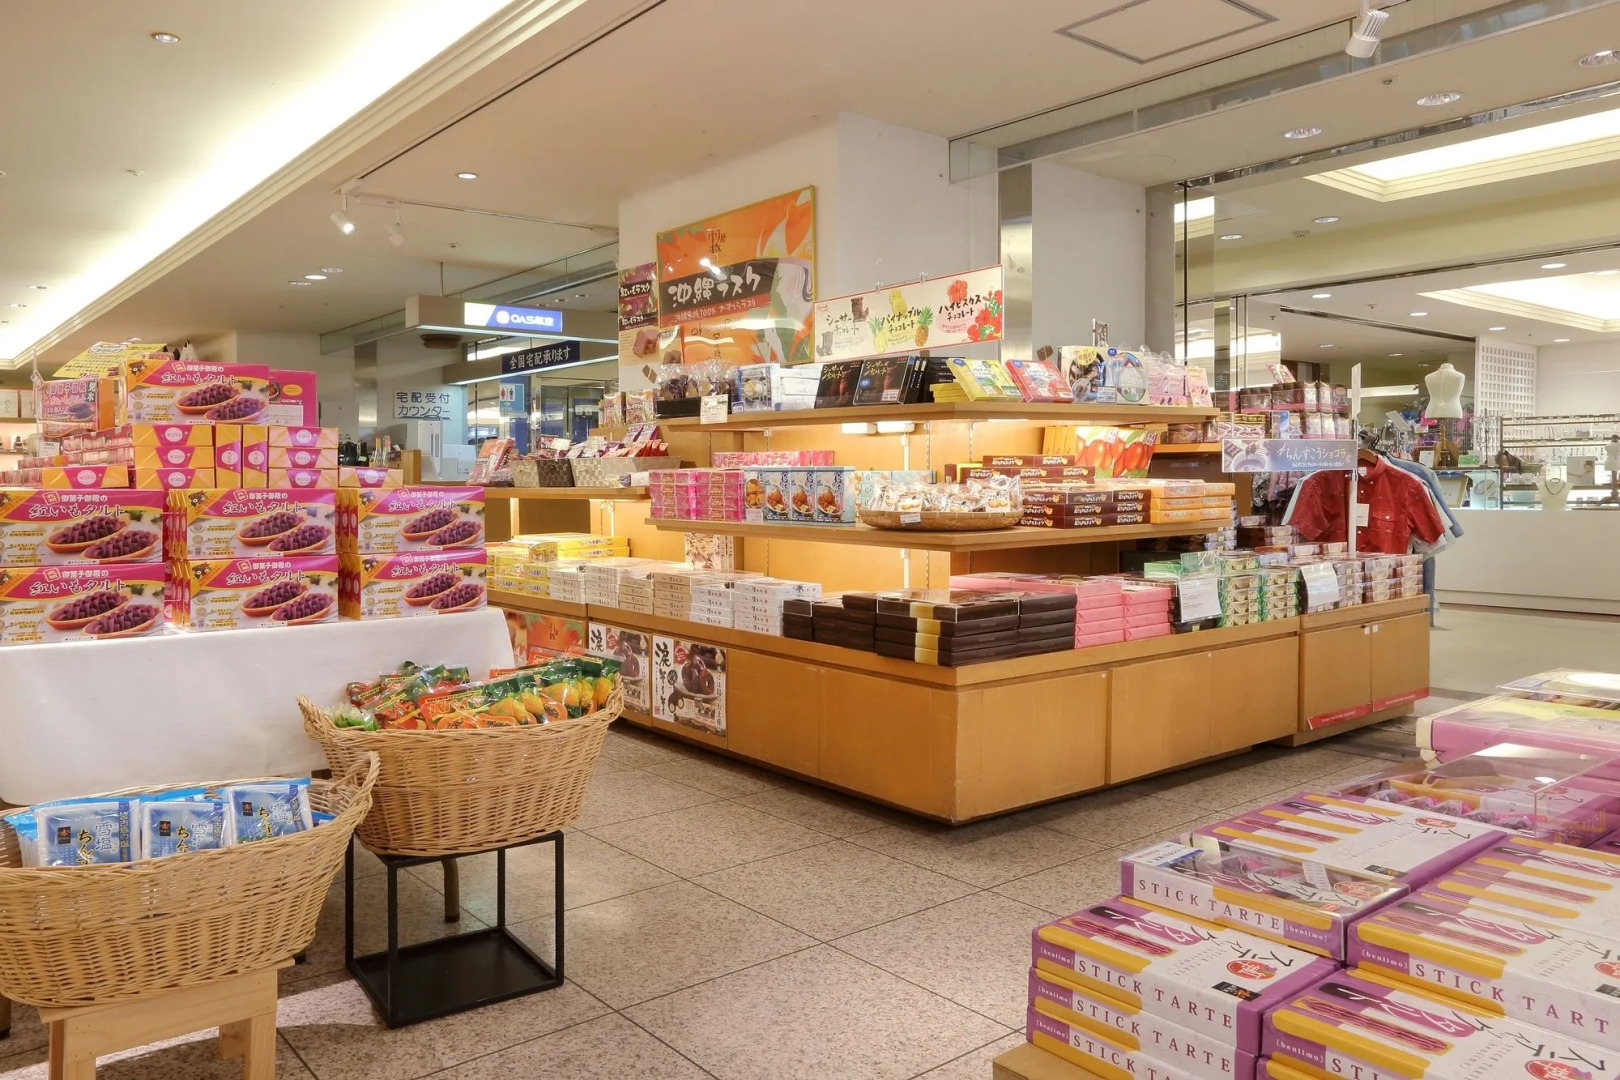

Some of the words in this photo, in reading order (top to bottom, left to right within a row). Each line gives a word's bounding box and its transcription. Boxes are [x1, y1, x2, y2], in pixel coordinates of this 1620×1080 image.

[668, 265, 761, 308] 沖縄ラスク
[881, 306, 922, 327] パイナップル
[938, 294, 982, 315] ハイビスカス
[946, 307, 975, 323] チョコレート
[888, 320, 915, 335] チョコレート
[509, 345, 571, 370] 全国宅配承ります
[396, 391, 450, 404] 宅配受付
[398, 405, 450, 417] カウンター
[94, 821, 112, 851] 雪塩
[1138, 878, 1200, 907] STICK
[1208, 899, 1281, 931] TARTE
[1078, 959, 1143, 995] STICK
[1154, 987, 1233, 1029] TARTE
[1415, 963, 1505, 1002] STICK
[1076, 999, 1142, 1036] STICK
[1152, 1029, 1231, 1073] TARTE
[1073, 1034, 1136, 1073] STICK
